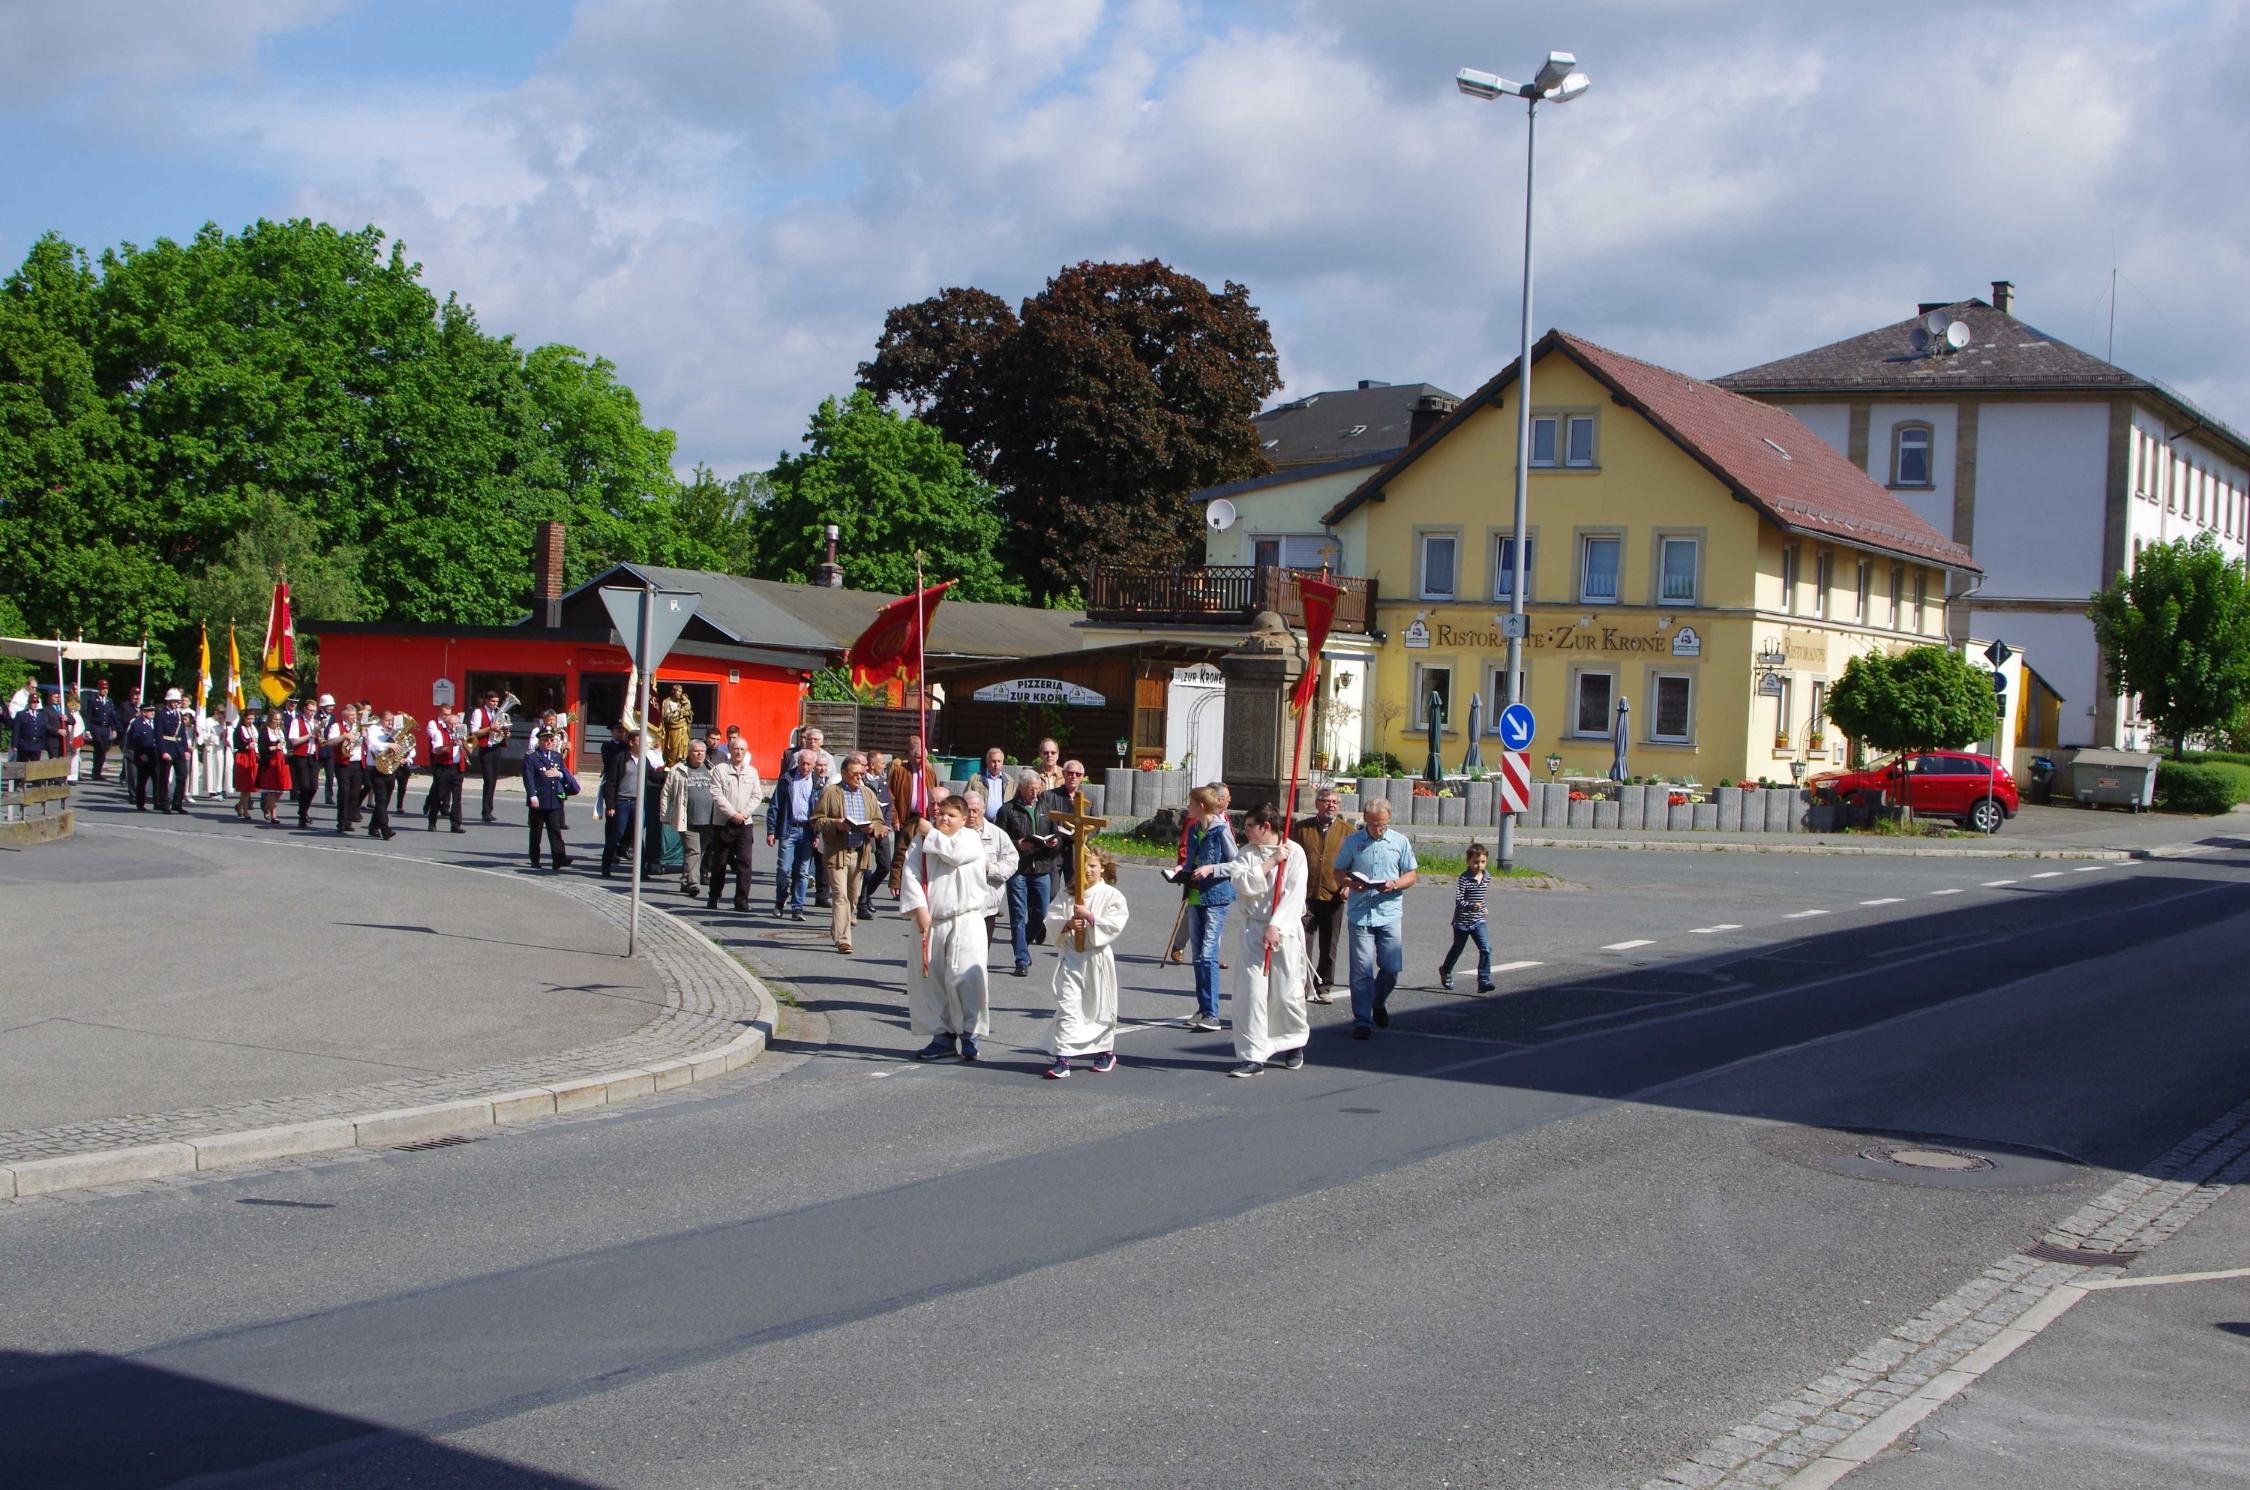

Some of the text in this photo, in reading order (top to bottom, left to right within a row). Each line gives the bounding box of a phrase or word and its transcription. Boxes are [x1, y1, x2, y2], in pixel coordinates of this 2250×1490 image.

[1017, 680, 1063, 690] PIZZERIA
[1010, 691, 1068, 702] ZUR KRONE
